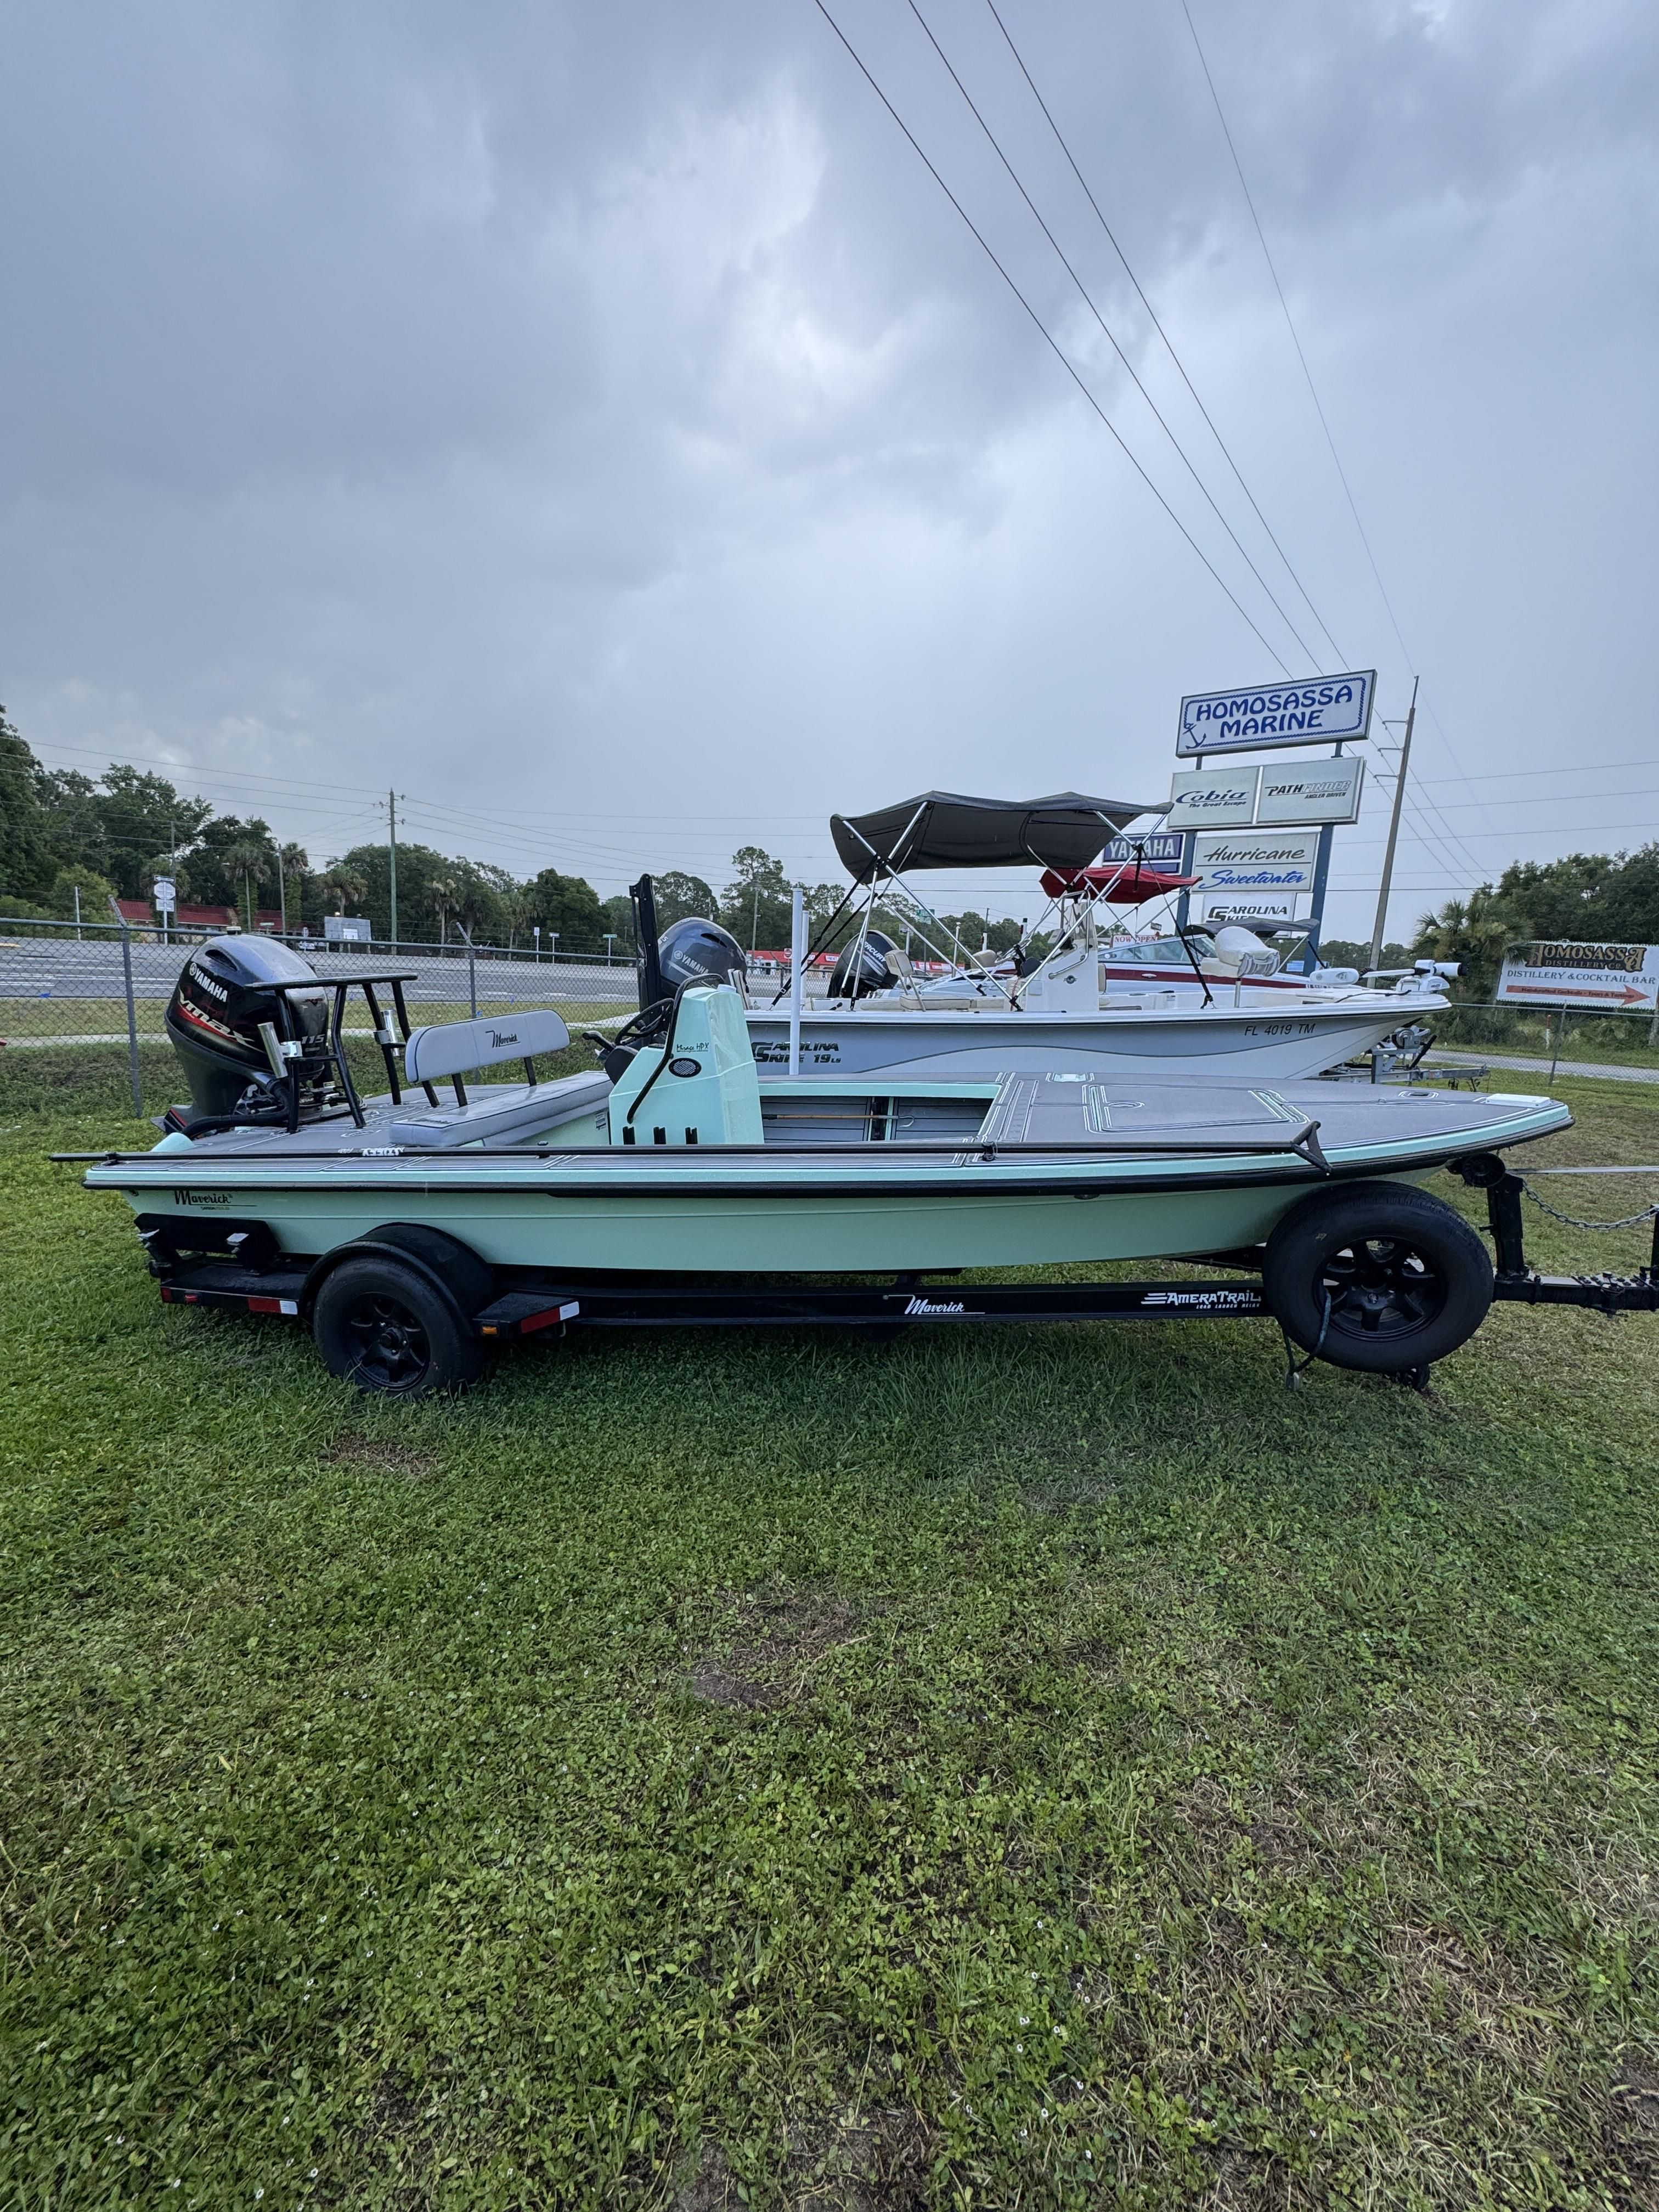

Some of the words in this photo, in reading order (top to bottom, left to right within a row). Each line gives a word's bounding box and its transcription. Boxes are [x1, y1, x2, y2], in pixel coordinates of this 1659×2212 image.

[1196, 685, 1352, 721] HOMOSASSA
[1220, 709, 1324, 738] MARINE
[1176, 789, 1247, 804] Cobia
[1265, 780, 1352, 797] PATHFINDER
[1203, 845, 1305, 862] Hurricane
[1198, 870, 1307, 889] Sweetwater
[1208, 906, 1288, 918] CAROLINA
[682, 955, 709, 975] YAMAHA
[1545, 960, 1606, 968] DISTILLERY
[194, 968, 228, 1002] YAMAHA
[1507, 970, 1566, 979] DISTILLERY
[1632, 977, 1656, 985] BAR
[1244, 1025, 1259, 1036] FL
[1265, 1024, 1292, 1035] 4019
[1299, 1023, 1316, 1034] TM
[301, 1034, 325, 1044] 115
[676, 1044, 695, 1052] Mirage
[696, 1042, 709, 1051] HPX
[174, 1189, 234, 1206] Maverick
[901, 1295, 972, 1314] Maverick
